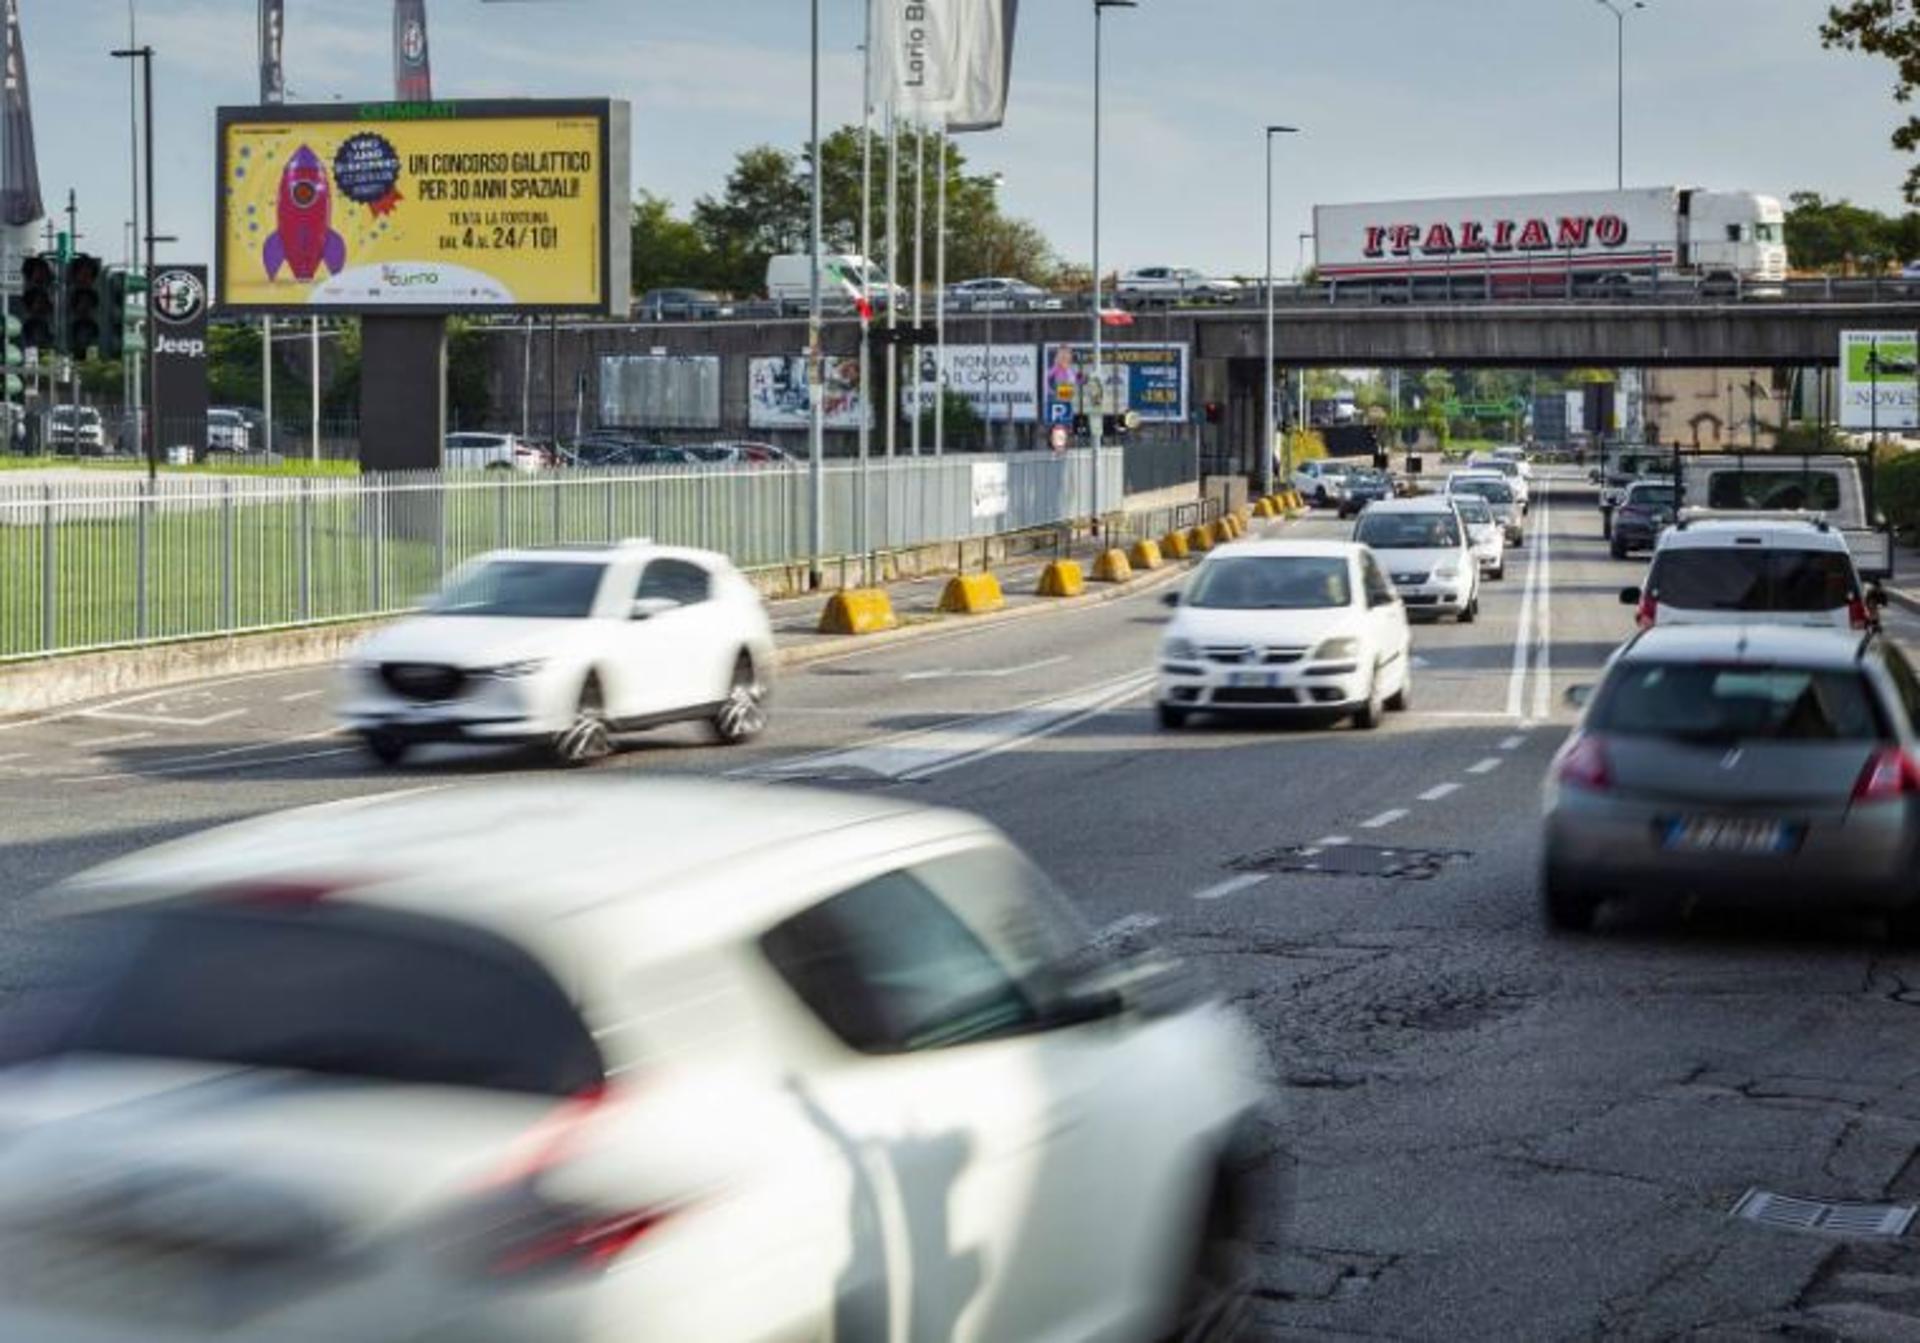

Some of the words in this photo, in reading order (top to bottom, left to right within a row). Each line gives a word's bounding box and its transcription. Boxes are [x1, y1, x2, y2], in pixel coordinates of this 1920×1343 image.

[904, 27, 924, 87] Lario
[409, 153, 428, 174] UN
[432, 153, 509, 173] CONCORSO
[512, 151, 591, 172] GALATTICO
[419, 179, 447, 200] PER
[450, 179, 469, 200] 30
[472, 179, 507, 199] ANNI
[449, 212, 481, 225] TENTA
[485, 212, 498, 223] LA
[500, 212, 549, 223] FORTUNA
[462, 227, 474, 248] 4
[1364, 215, 1628, 257] ITALIANO
[154, 335, 204, 357] Jeep
[953, 355, 985, 368] NON
[1051, 404, 1067, 421] P
